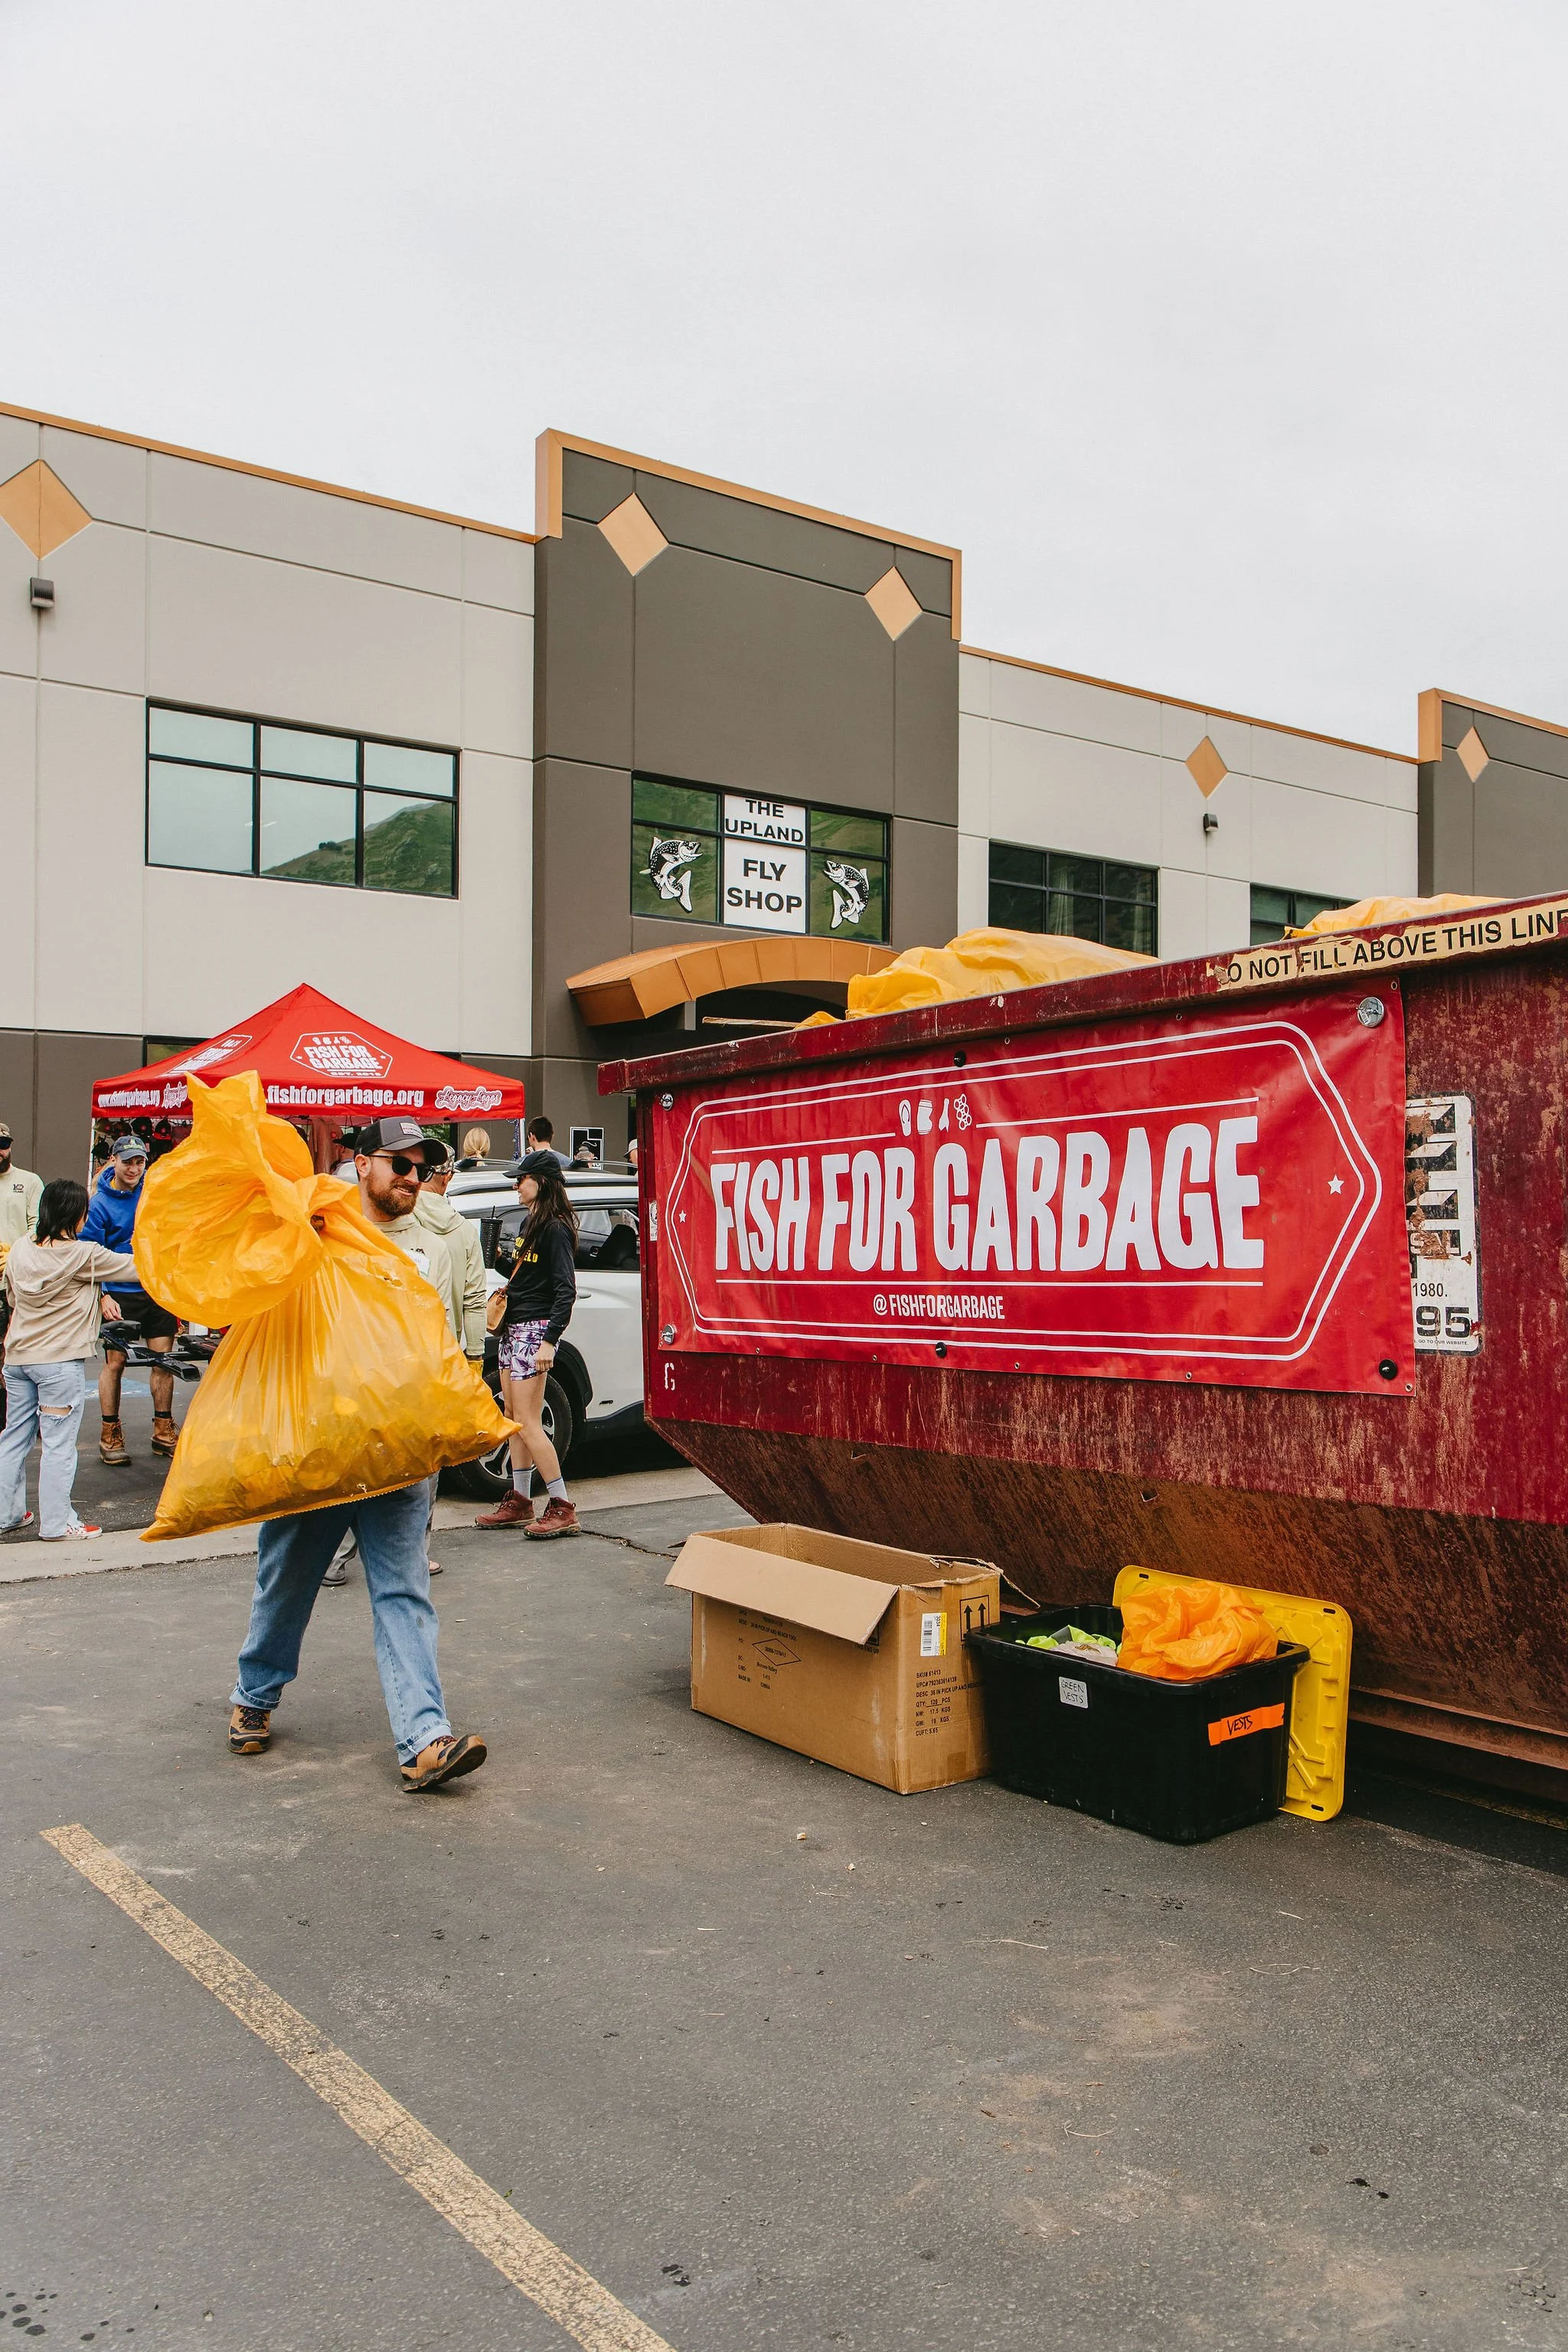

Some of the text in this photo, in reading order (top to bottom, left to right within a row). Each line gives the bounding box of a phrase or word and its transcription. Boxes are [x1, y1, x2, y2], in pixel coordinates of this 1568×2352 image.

[745, 799, 784, 818] THE
[725, 818, 803, 842] UPLAND
[743, 858, 786, 881] FLY
[727, 887, 802, 913] SHOP
[1227, 962, 1242, 982] O
[1250, 955, 1292, 980] NOT
[1301, 947, 1346, 972] FILL
[1353, 931, 1437, 965] ABOVE
[1442, 920, 1501, 950] THIS
[303, 1045, 371, 1058] FISH FOR
[309, 1058, 383, 1069] GARBAGE
[265, 1085, 501, 1109] .fishforgarbage.org Legacy Logos
[710, 1156, 811, 1271] FISH
[818, 1147, 918, 1272] FOR
[933, 1116, 1264, 1272] GARBAGE
[1413, 1282, 1448, 1297] 1980.
[873, 1294, 1005, 1319] @FISHFORGARBAGE
[1062, 1680, 1084, 1693] GREEN
[1063, 1690, 1084, 1704] VESTS
[1227, 1715, 1253, 1736] VESTS
